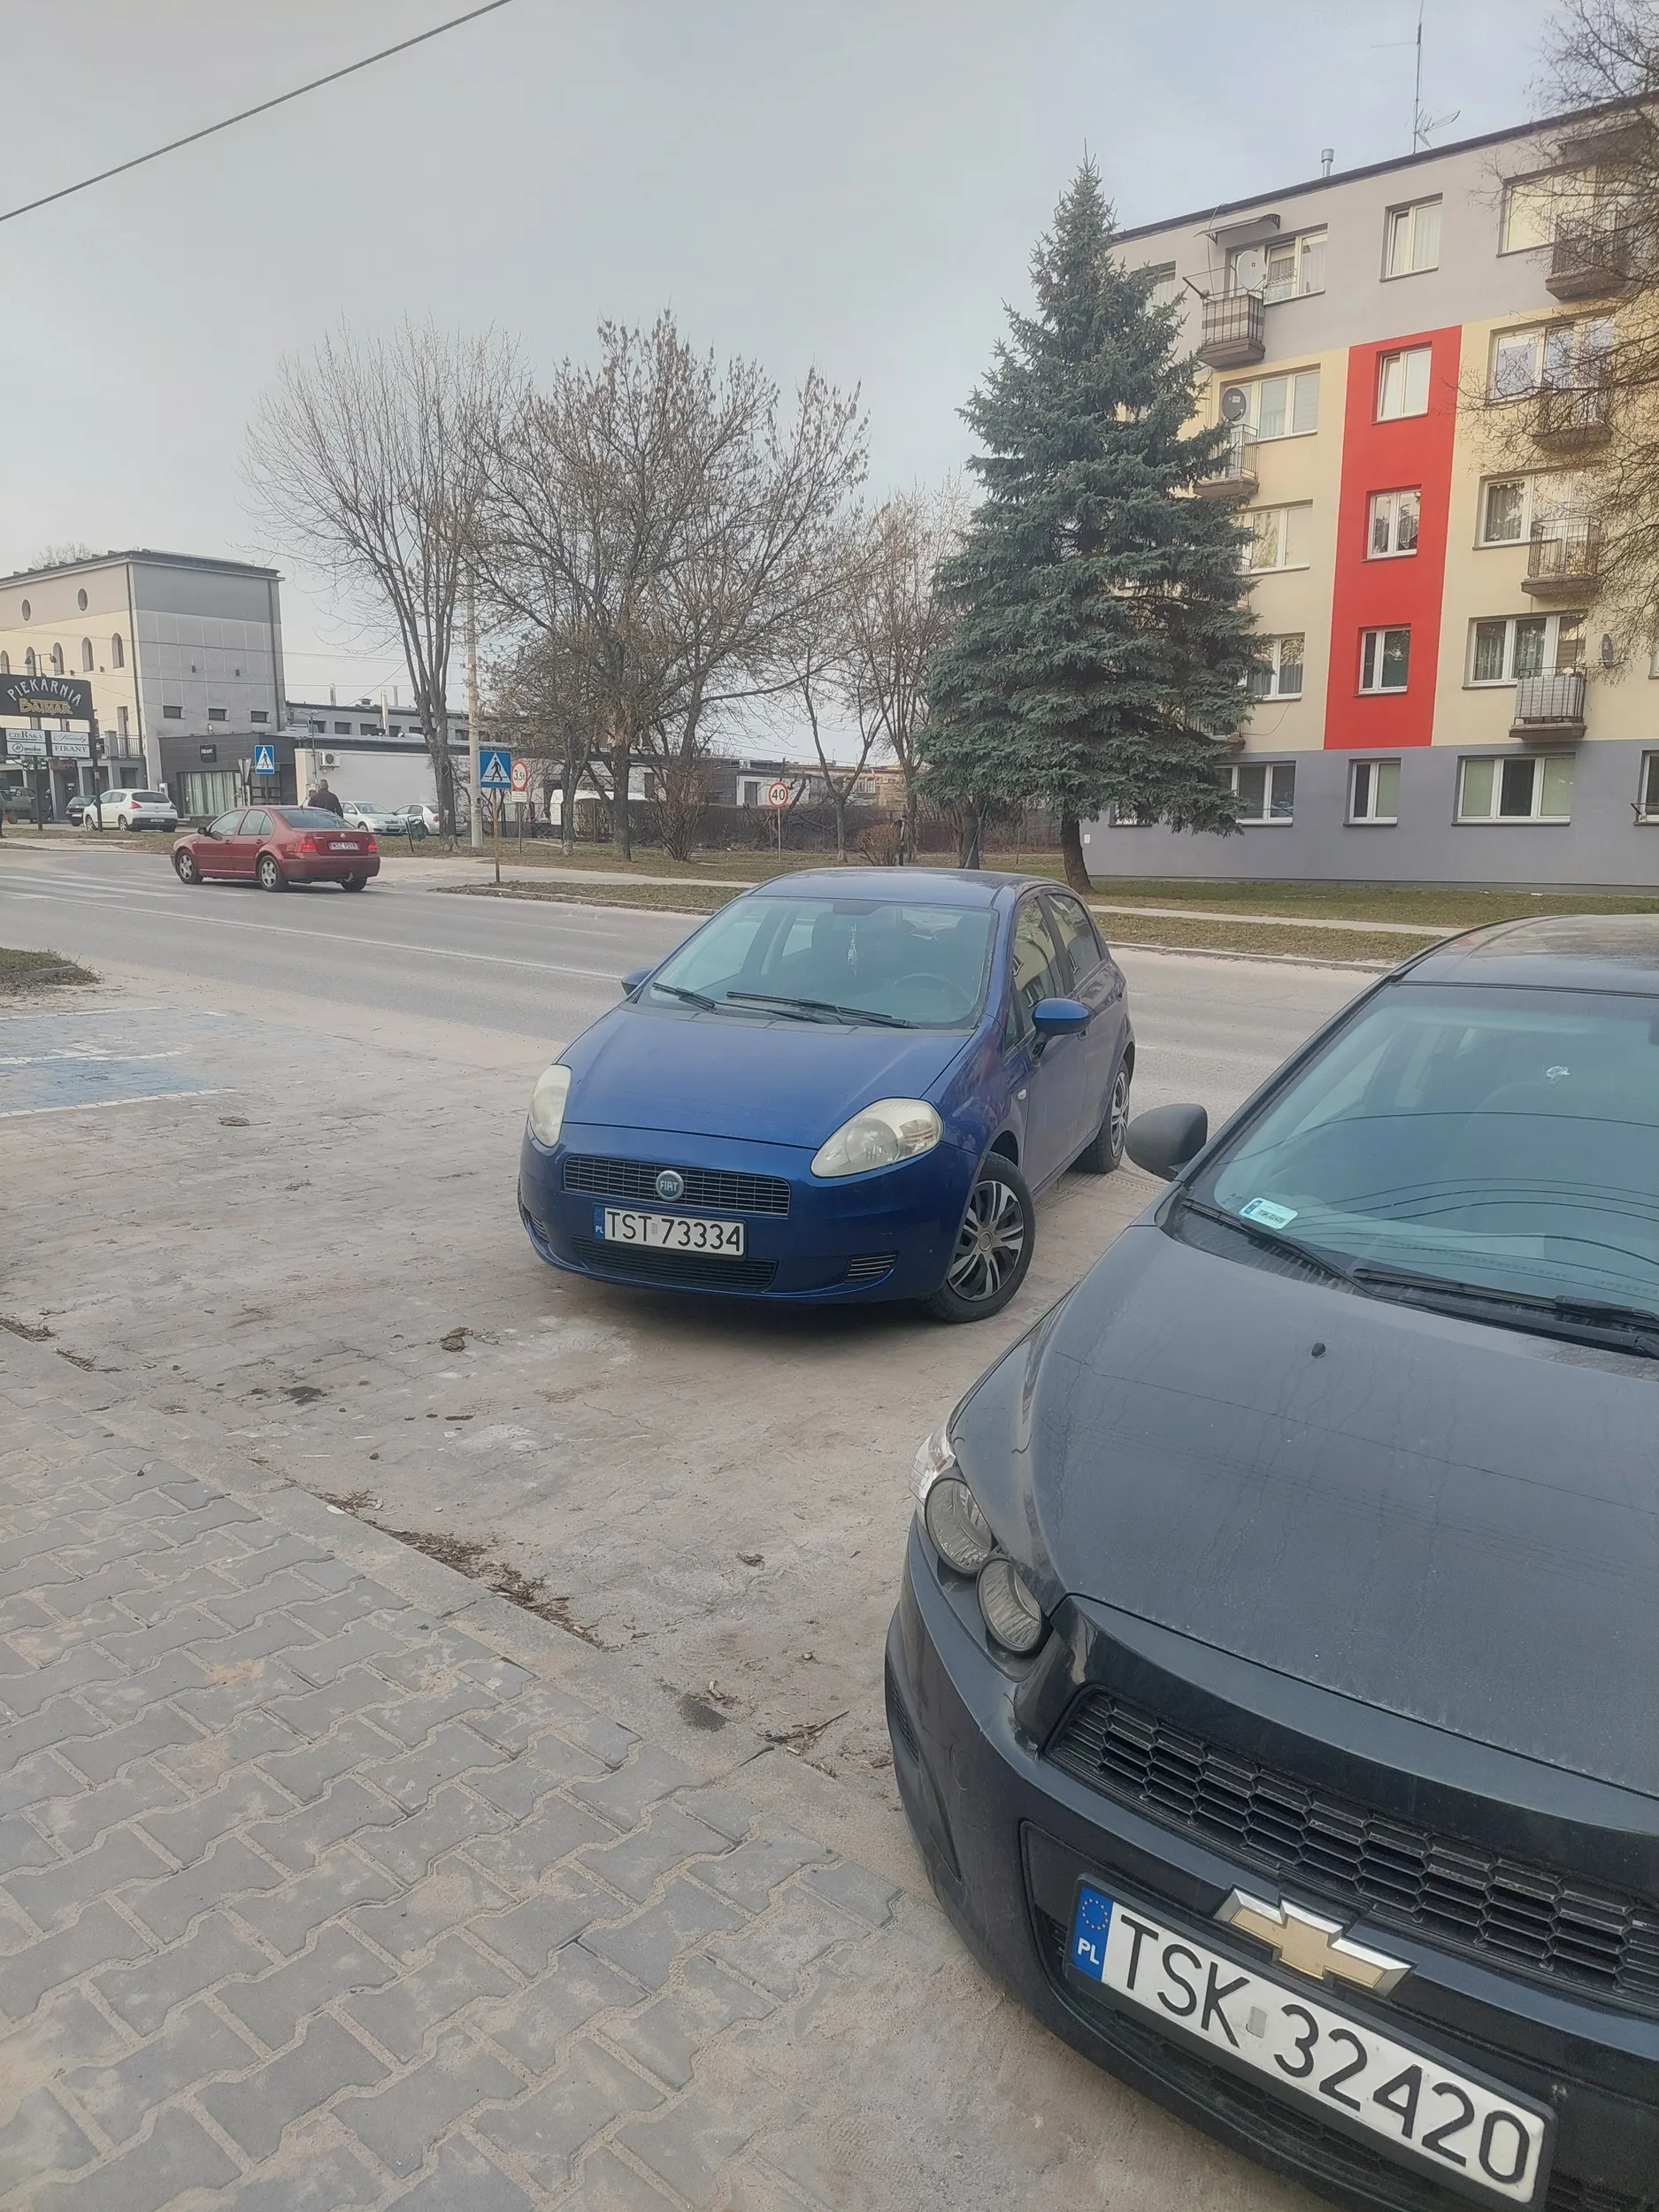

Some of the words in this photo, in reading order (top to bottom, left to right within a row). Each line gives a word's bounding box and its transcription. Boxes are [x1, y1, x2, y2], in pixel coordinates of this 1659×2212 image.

[6, 678, 82, 707] PIEKARNIA
[772, 788, 786, 801] 40
[659, 1179, 679, 1192] FIAT
[607, 1210, 652, 1242] TST
[661, 1217, 741, 1252] 73334
[1077, 1936, 1100, 1966] PL
[1119, 1914, 1250, 2049] TSK
[1272, 2002, 1530, 2185] 32420
